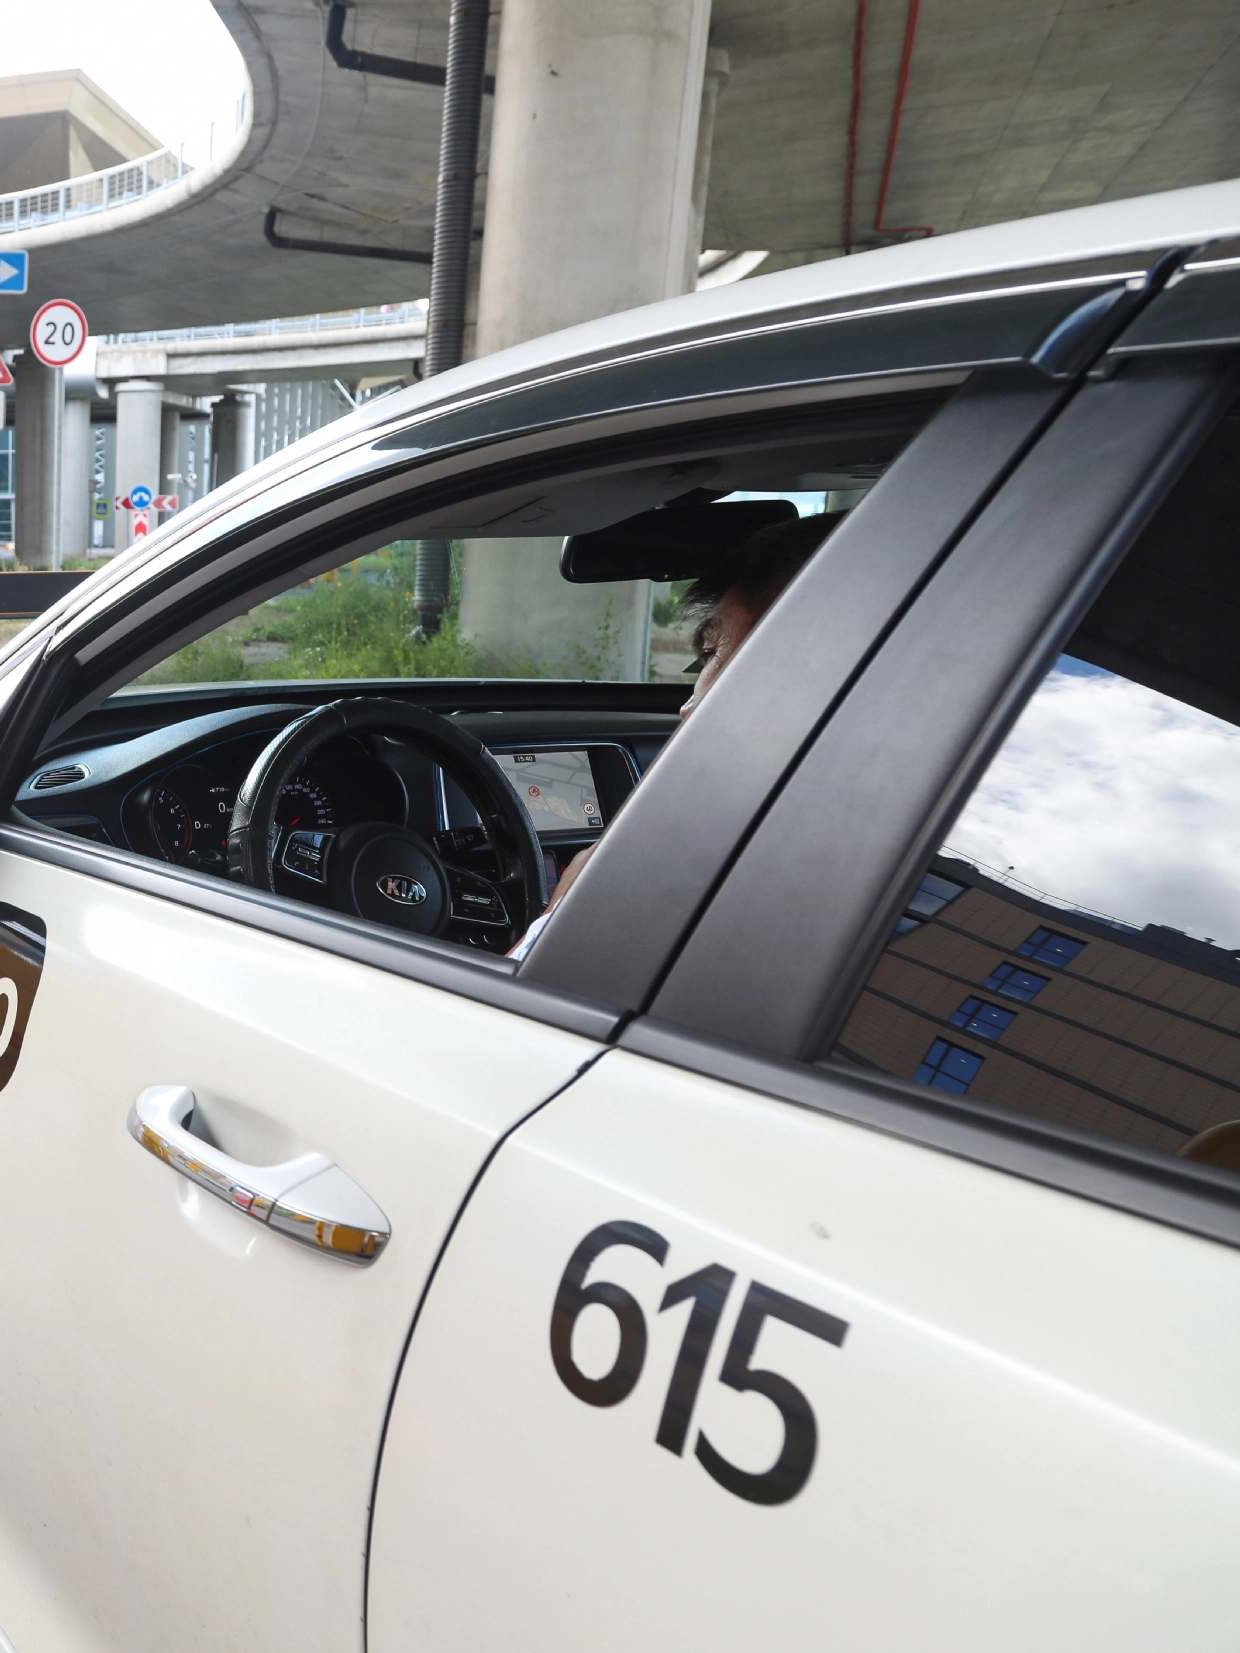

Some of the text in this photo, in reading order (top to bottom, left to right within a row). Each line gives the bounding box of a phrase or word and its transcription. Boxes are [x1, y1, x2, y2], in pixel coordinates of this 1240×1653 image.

[44, 322, 75, 346] 20
[218, 802, 226, 813] 0
[386, 877, 425, 901] KIA
[550, 1219, 851, 1507] 615
